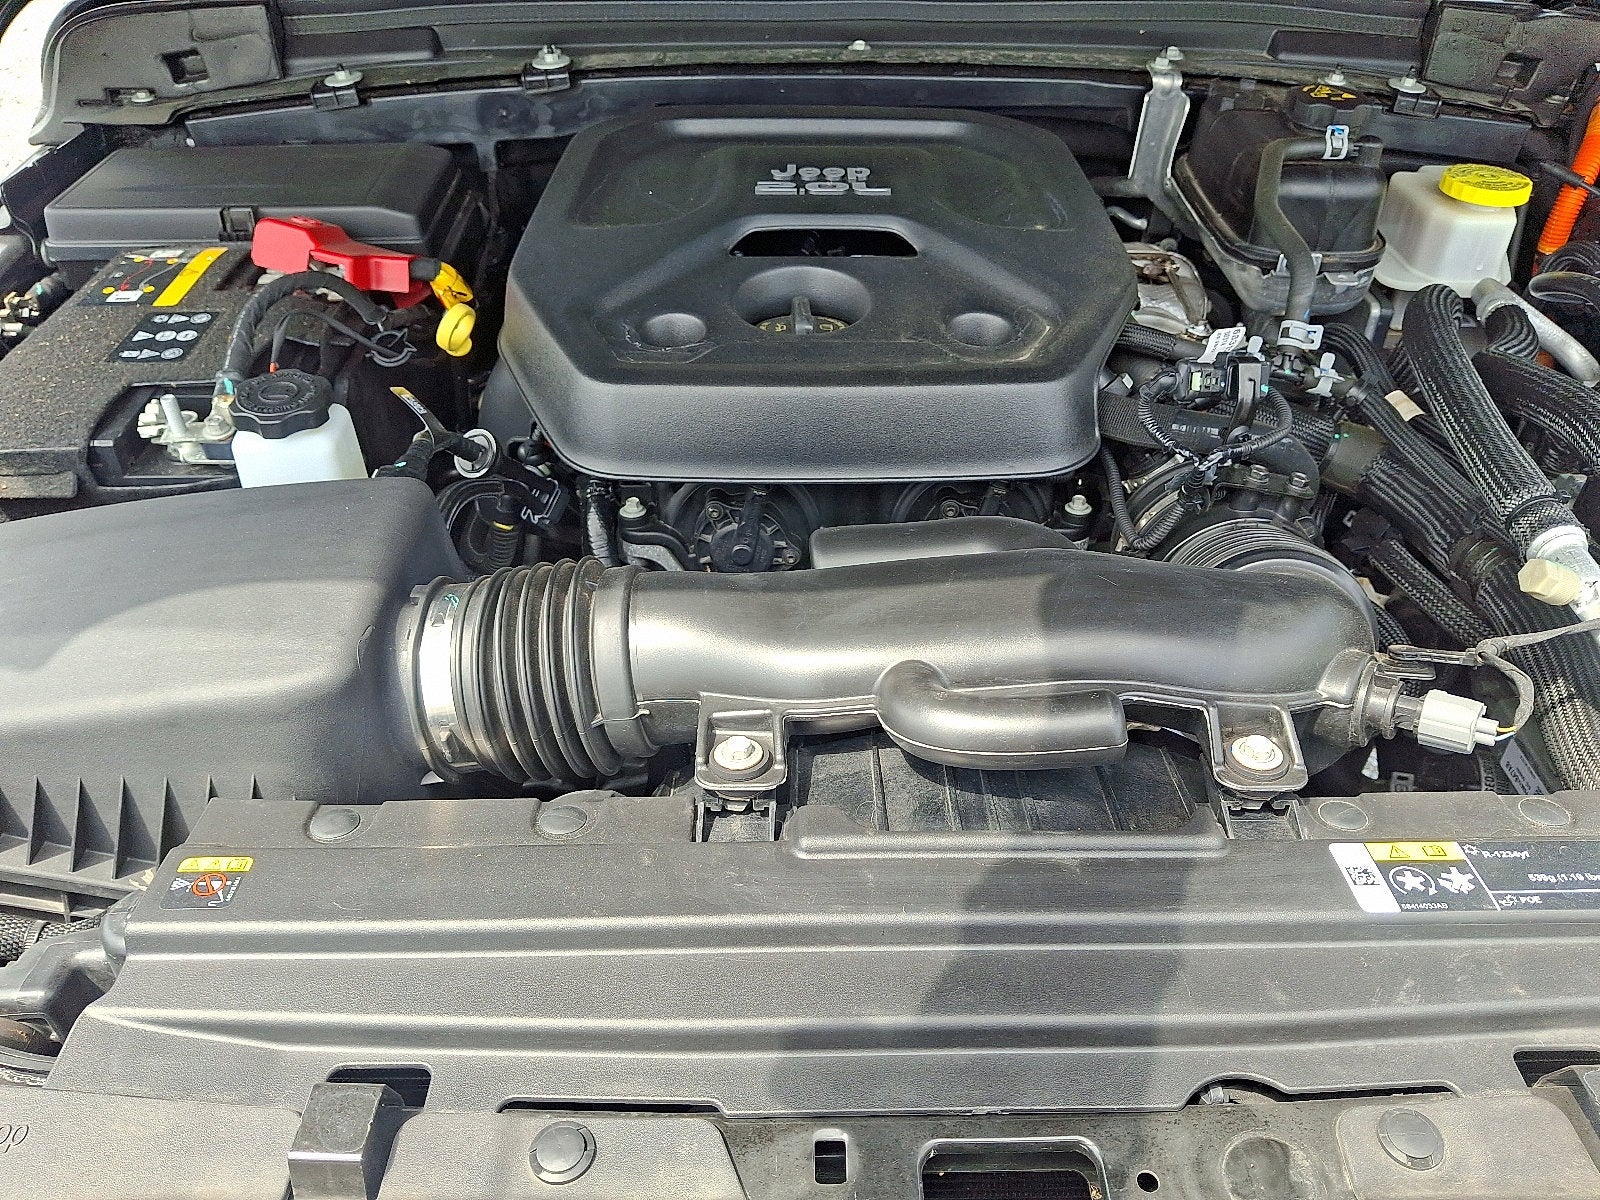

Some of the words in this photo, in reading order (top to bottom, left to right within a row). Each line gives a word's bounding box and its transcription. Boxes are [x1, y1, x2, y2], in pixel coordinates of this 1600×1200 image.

[770, 164, 871, 183] Jeep
[755, 181, 892, 196] 2.0L
[1519, 896, 1542, 904] POE
